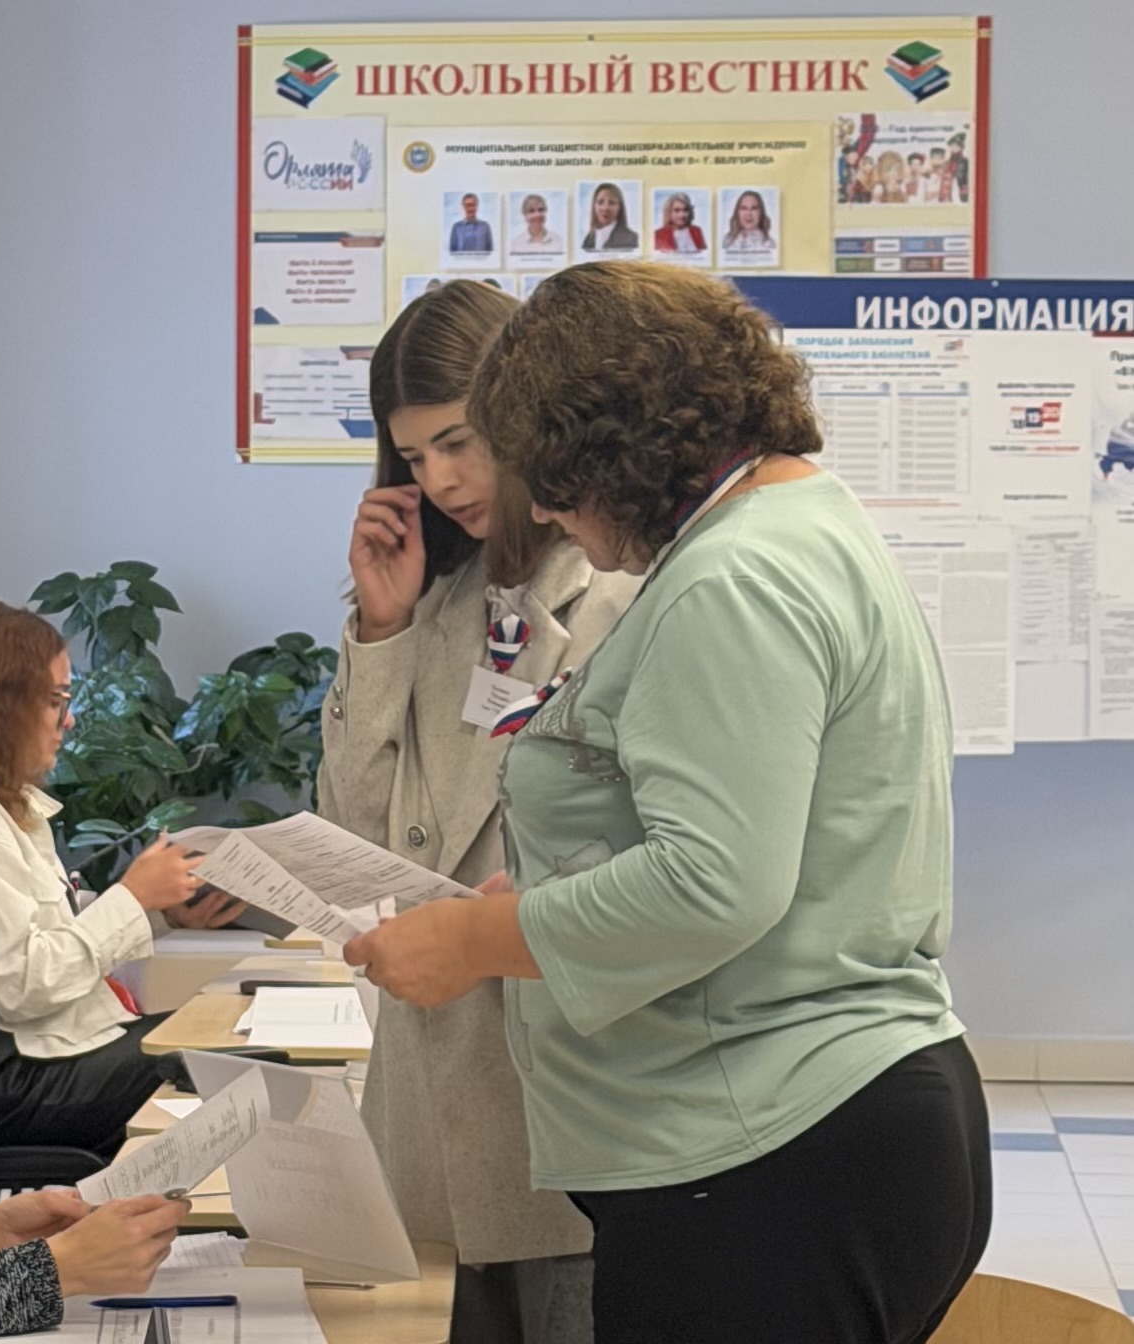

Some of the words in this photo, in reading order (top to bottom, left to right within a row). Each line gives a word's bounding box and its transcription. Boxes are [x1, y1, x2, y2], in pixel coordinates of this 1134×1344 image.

[355, 55, 633, 97] ШКОЛЬНЫЙ
[649, 59, 869, 94] ВЕСТНИК
[856, 295, 1134, 331] ИНФОРМАЦИЯ
